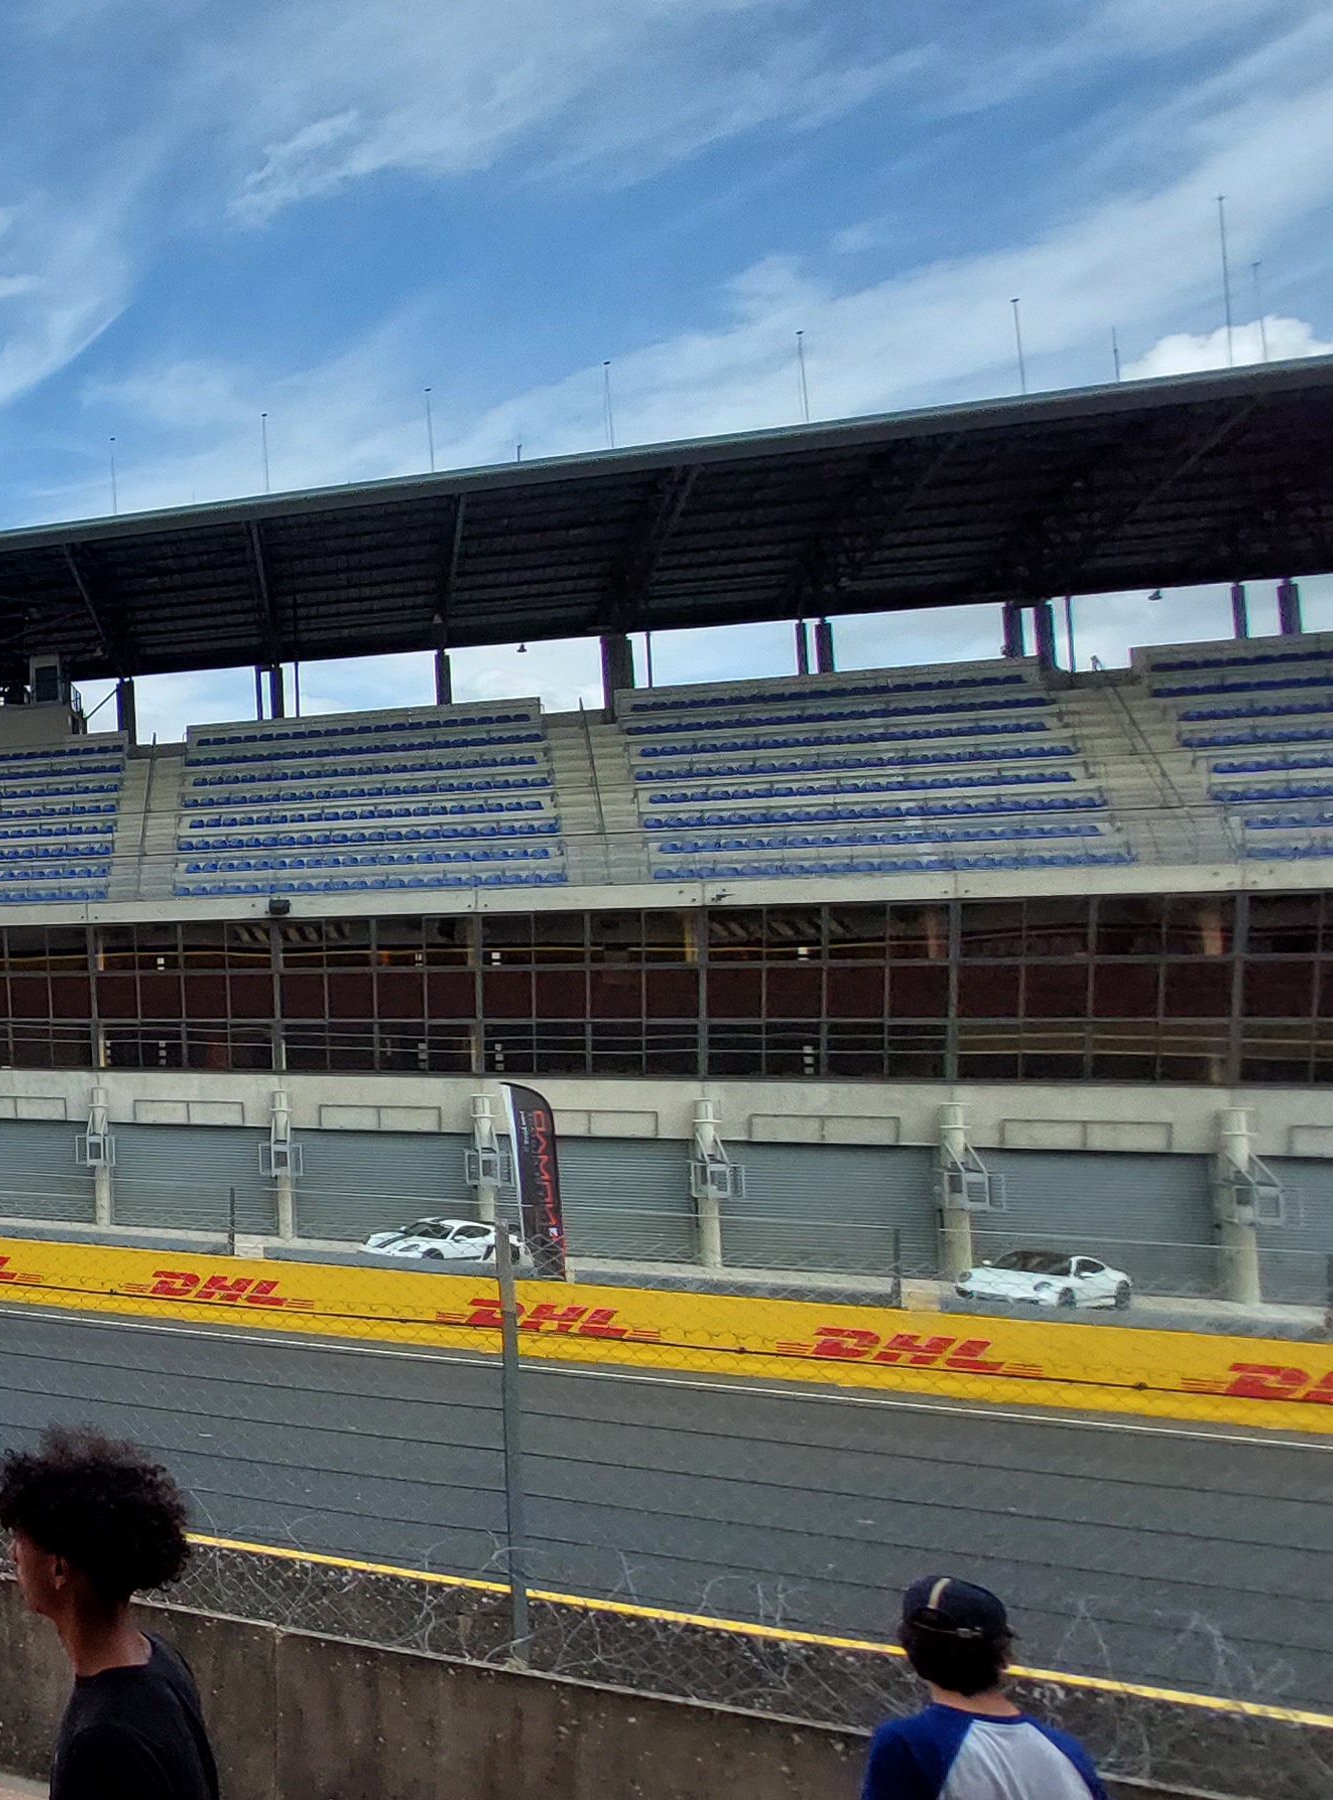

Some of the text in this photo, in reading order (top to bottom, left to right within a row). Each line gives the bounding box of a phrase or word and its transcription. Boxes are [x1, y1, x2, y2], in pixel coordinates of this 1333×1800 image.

[149, 1270, 287, 1307] DHL
[466, 1298, 629, 1337] DHL
[811, 1327, 1004, 1372] DHL
